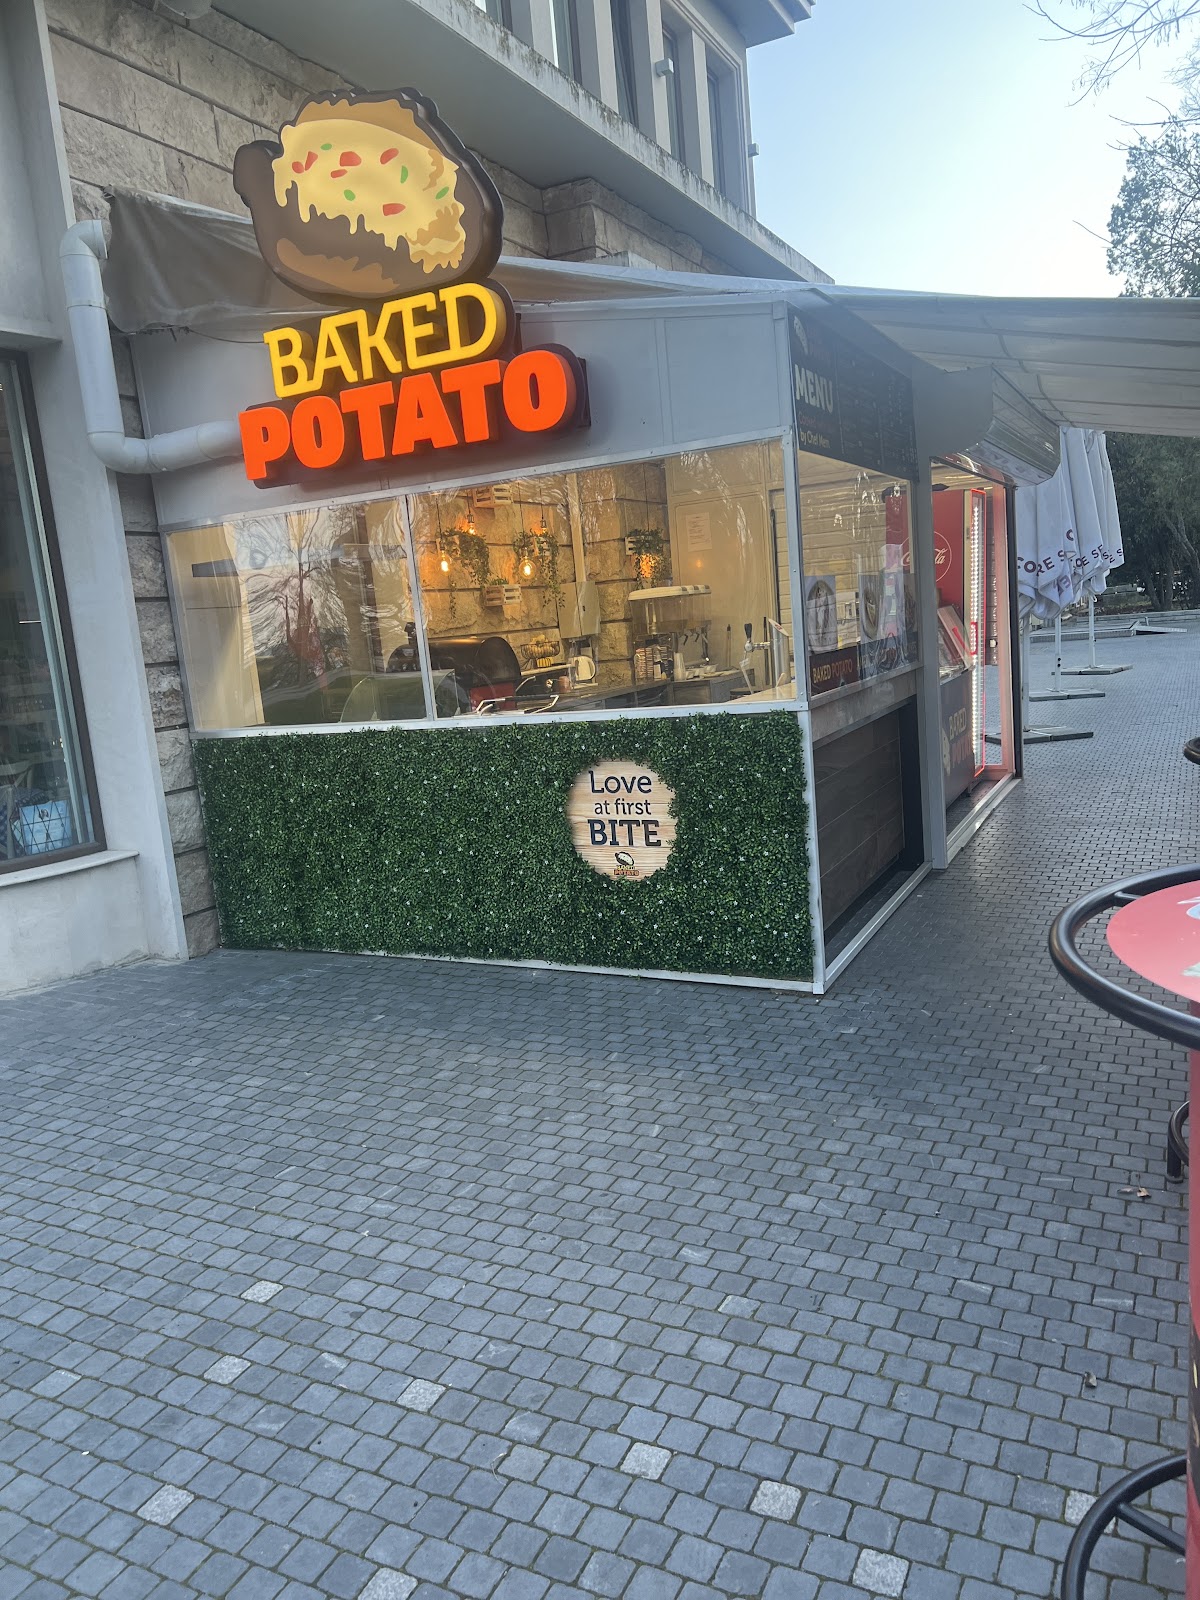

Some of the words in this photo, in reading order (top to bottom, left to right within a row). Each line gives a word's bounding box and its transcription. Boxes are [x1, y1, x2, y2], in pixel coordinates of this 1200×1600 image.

[262, 282, 500, 398] BAKED
[794, 363, 834, 415] MENU
[239, 350, 570, 480] POTATO
[812, 665, 831, 684] BAKED
[831, 658, 853, 678] POTATO
[588, 770, 652, 794] Love
[594, 800, 610, 815] at
[614, 798, 652, 815] first
[587, 819, 662, 847] BITE
